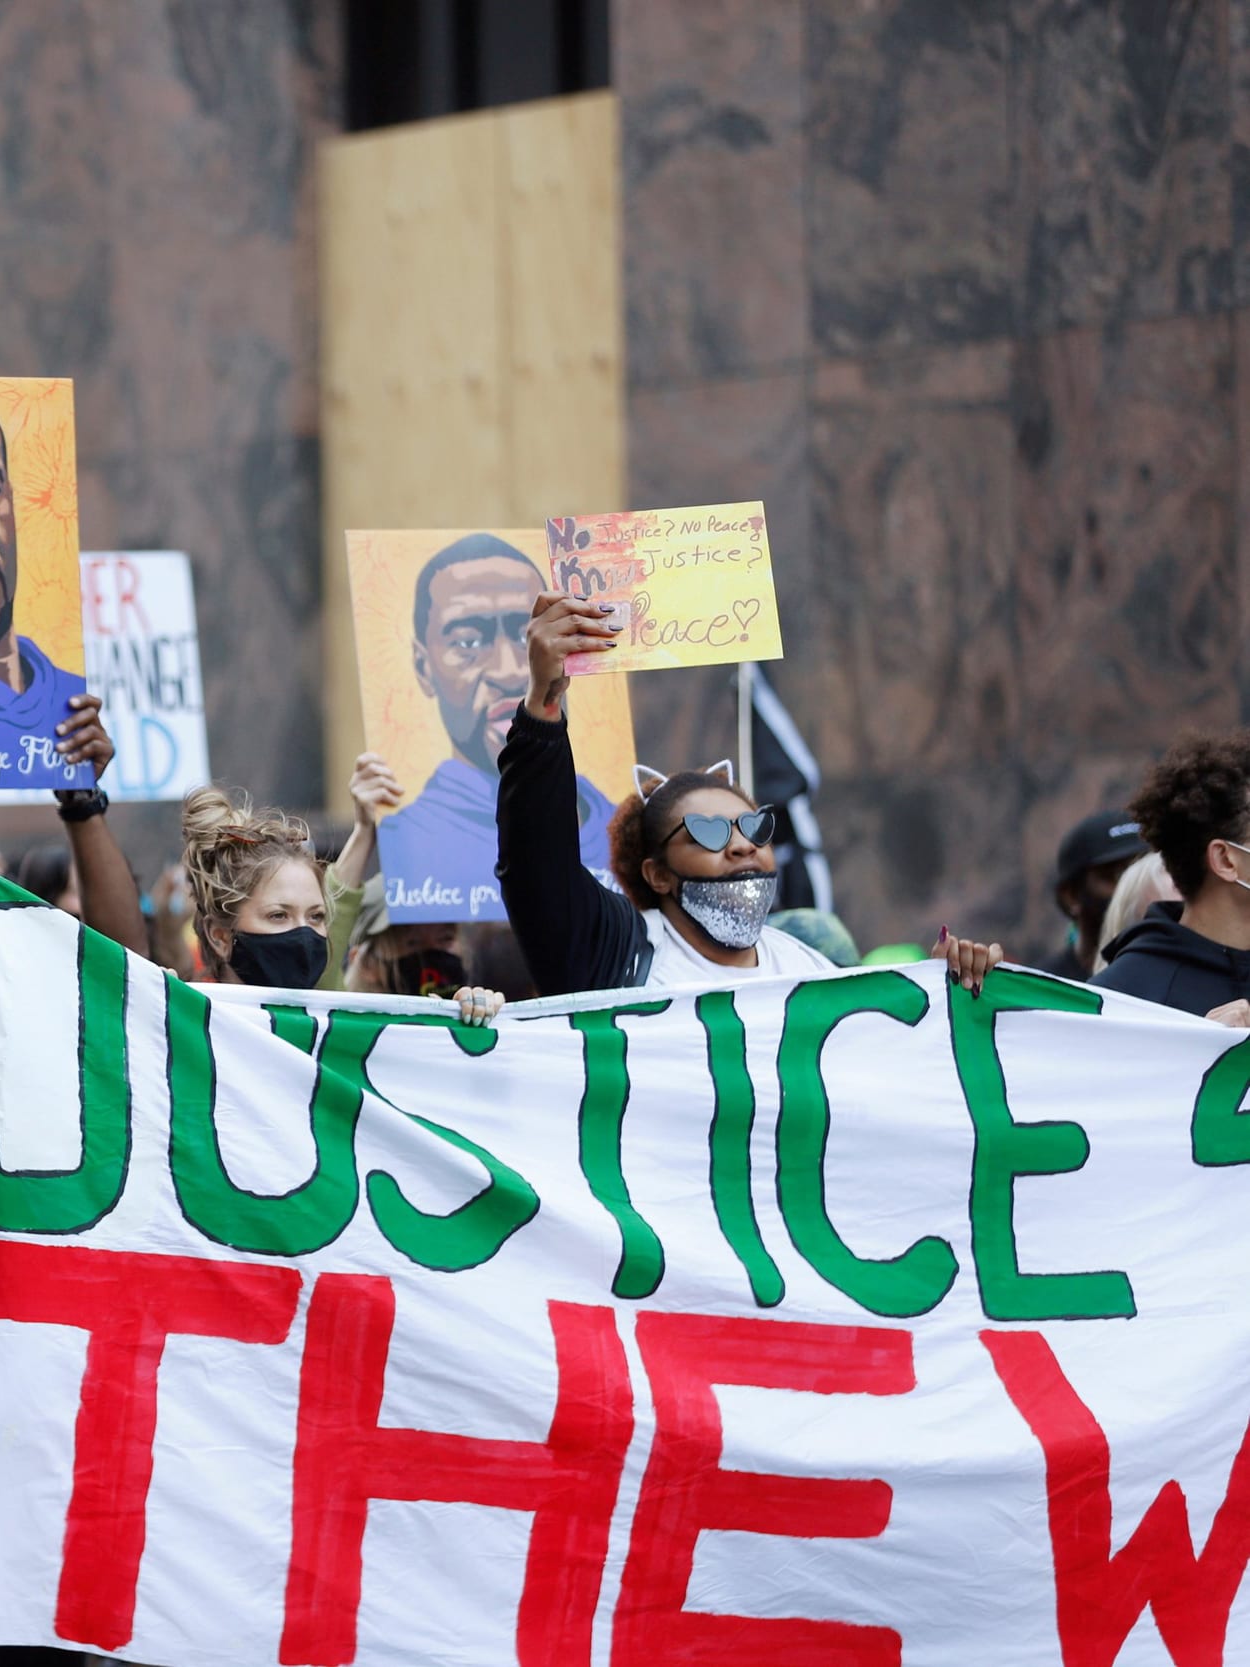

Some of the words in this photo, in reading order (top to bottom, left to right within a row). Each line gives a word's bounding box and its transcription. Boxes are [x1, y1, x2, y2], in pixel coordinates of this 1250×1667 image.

[597, 519, 675, 545] Justice?
[641, 545, 763, 577] Justice?
[385, 876, 464, 908] Justice
[469, 884, 500, 916] for
